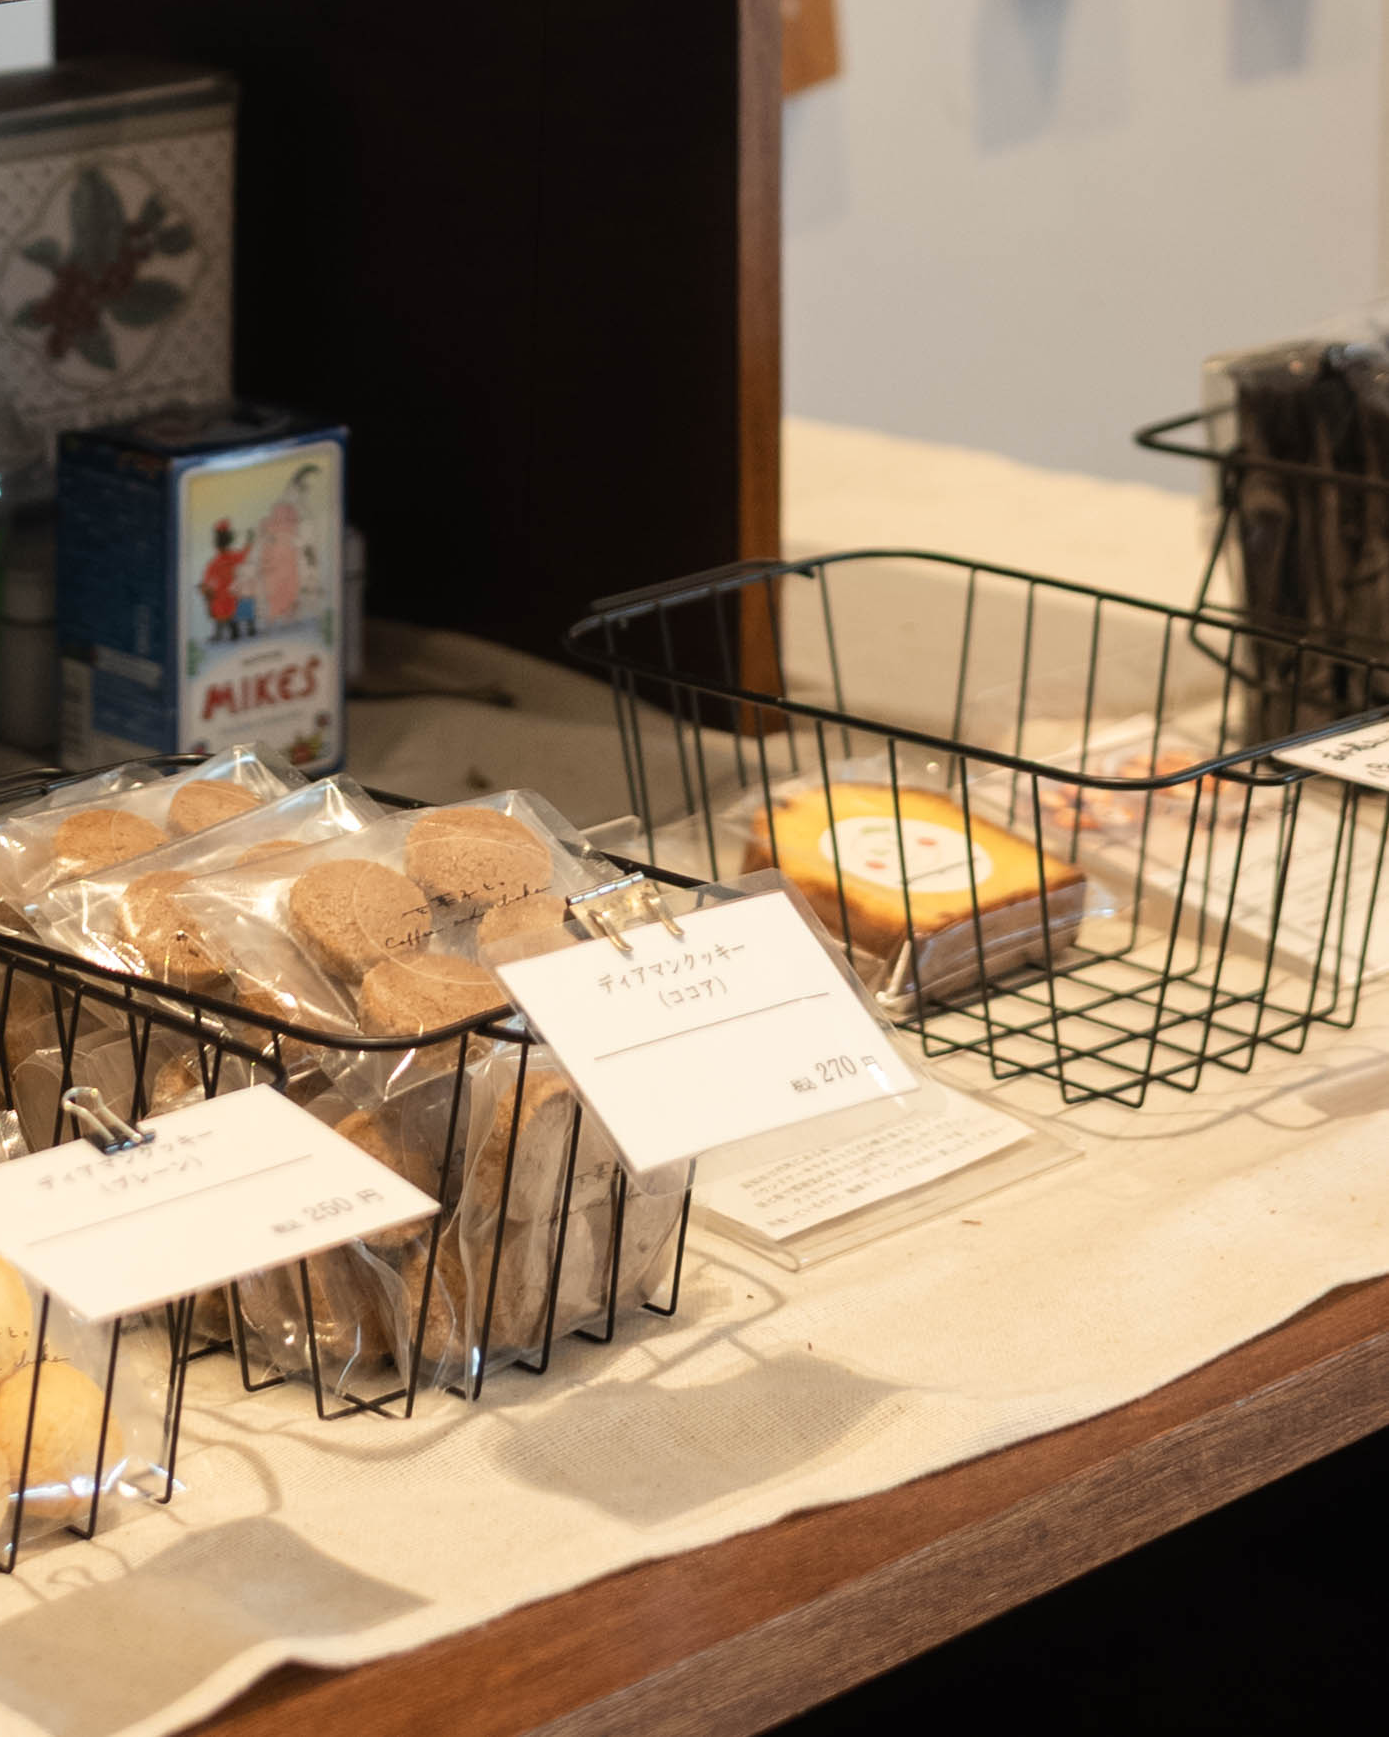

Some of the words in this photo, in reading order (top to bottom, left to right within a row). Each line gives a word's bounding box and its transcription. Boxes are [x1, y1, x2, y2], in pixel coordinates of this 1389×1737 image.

[815, 1054, 857, 1086] 270
[305, 1195, 356, 1225] 250
[358, 1186, 385, 1206] 円
